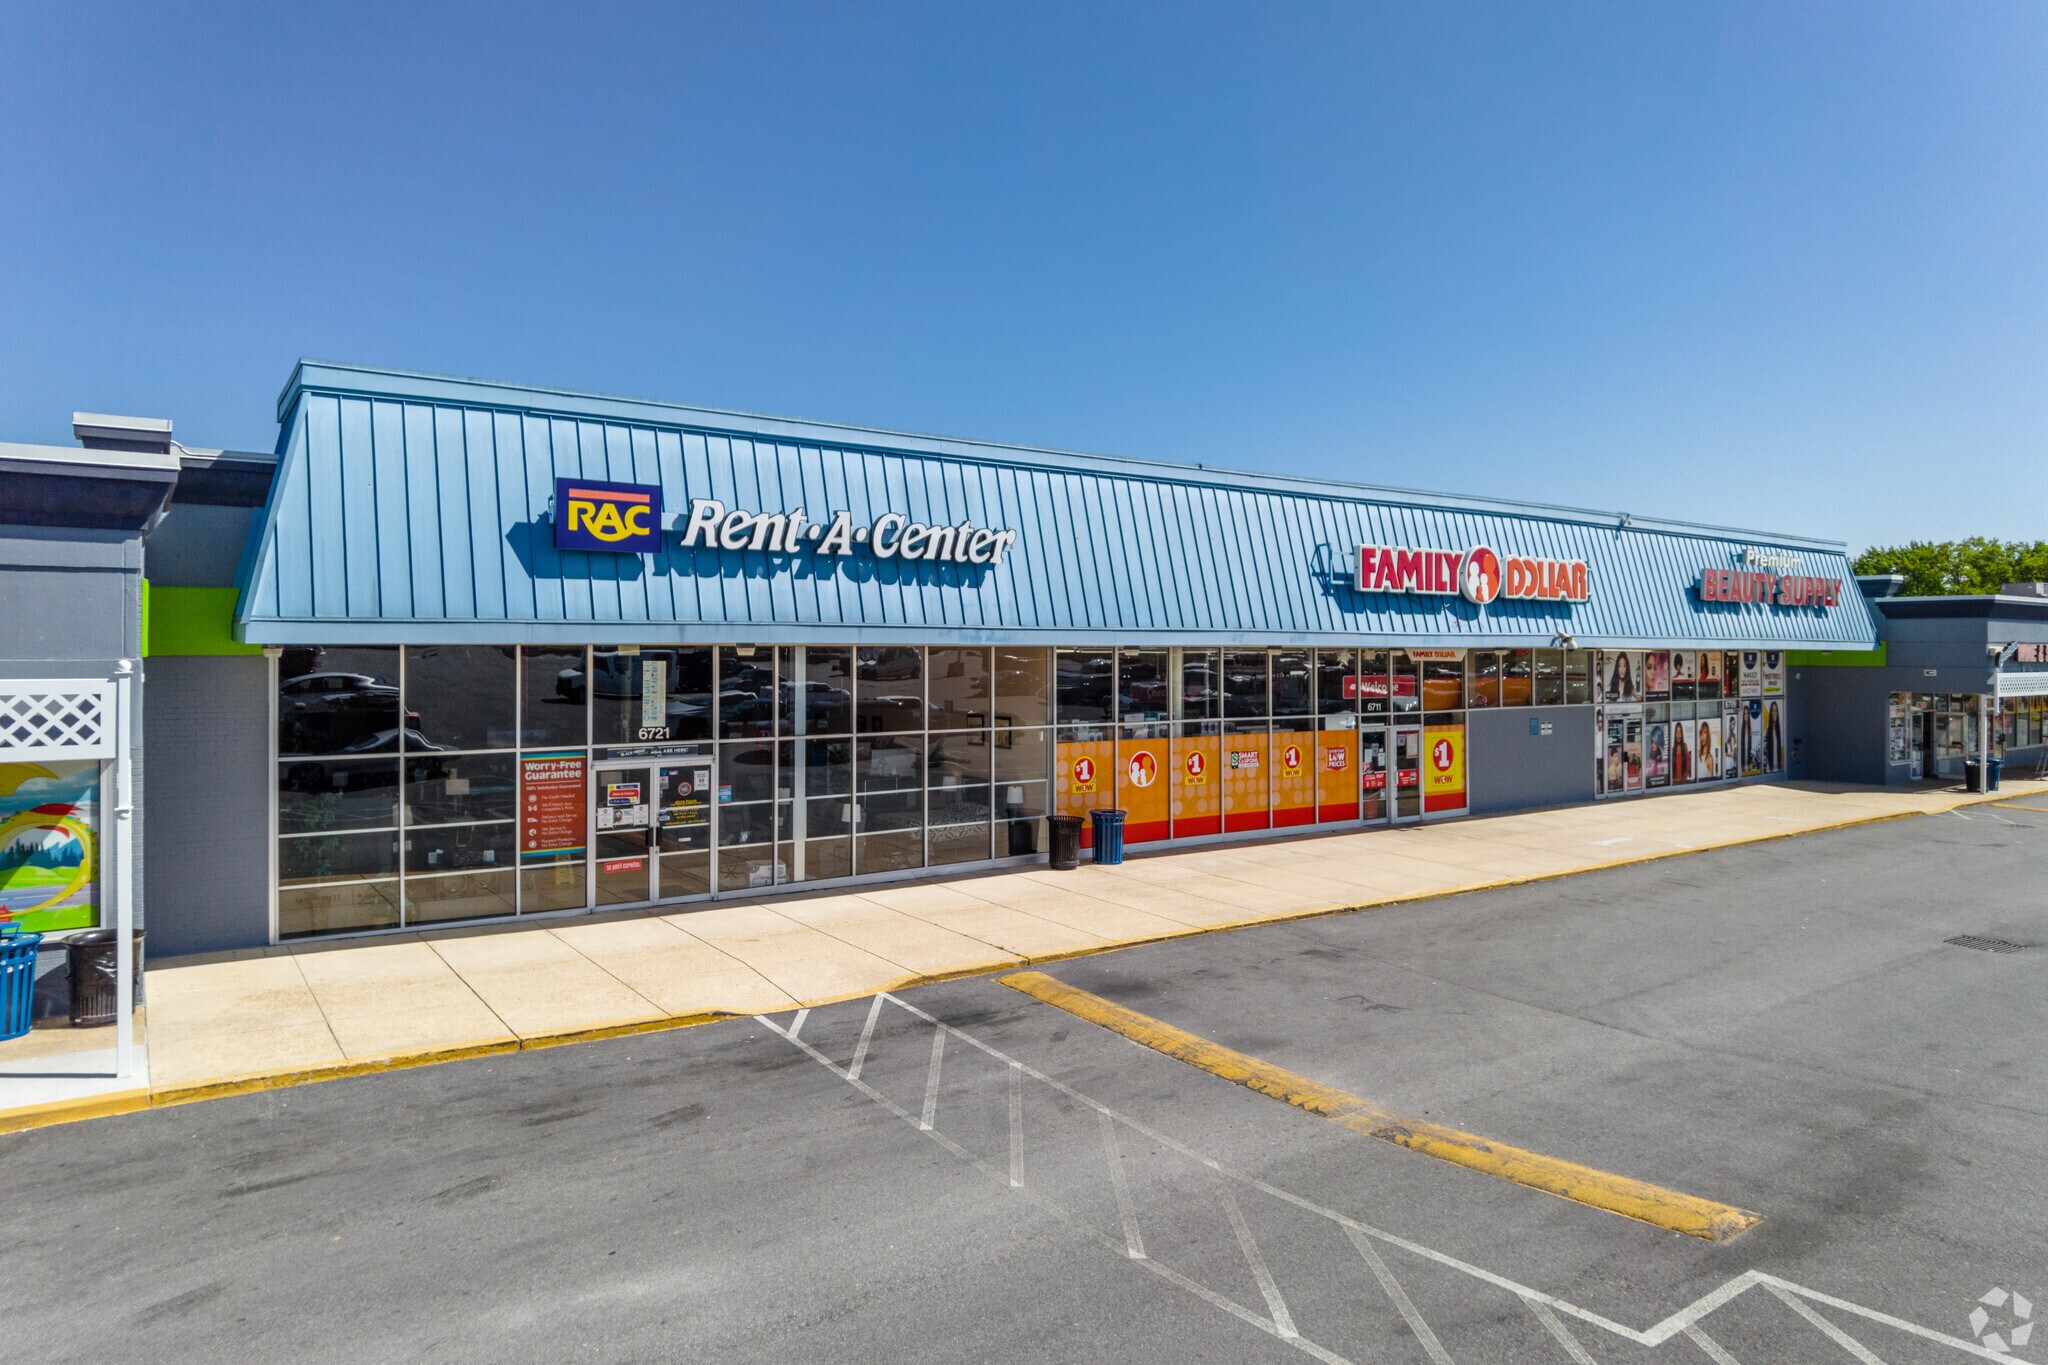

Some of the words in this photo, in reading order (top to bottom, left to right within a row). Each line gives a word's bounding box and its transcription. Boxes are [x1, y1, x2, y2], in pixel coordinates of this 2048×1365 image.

[568, 500, 650, 542] RAC
[1747, 551, 1801, 569] Premium
[1361, 547, 1463, 592] FAMILY
[1507, 557, 1587, 599] DOLLAR
[1702, 568, 1777, 603] BEAUTY
[1779, 574, 1842, 607] SUPPLY
[1367, 703, 1381, 711] 6711
[638, 727, 670, 740] 6721
[1188, 754, 1200, 773] $1
[1238, 751, 1258, 759] SMART
[1286, 746, 1297, 767] $1
[1434, 741, 1449, 767] $1
[525, 761, 581, 771] Worry-Free
[525, 770, 581, 780] Guarantee
[1075, 760, 1090, 780] $1
